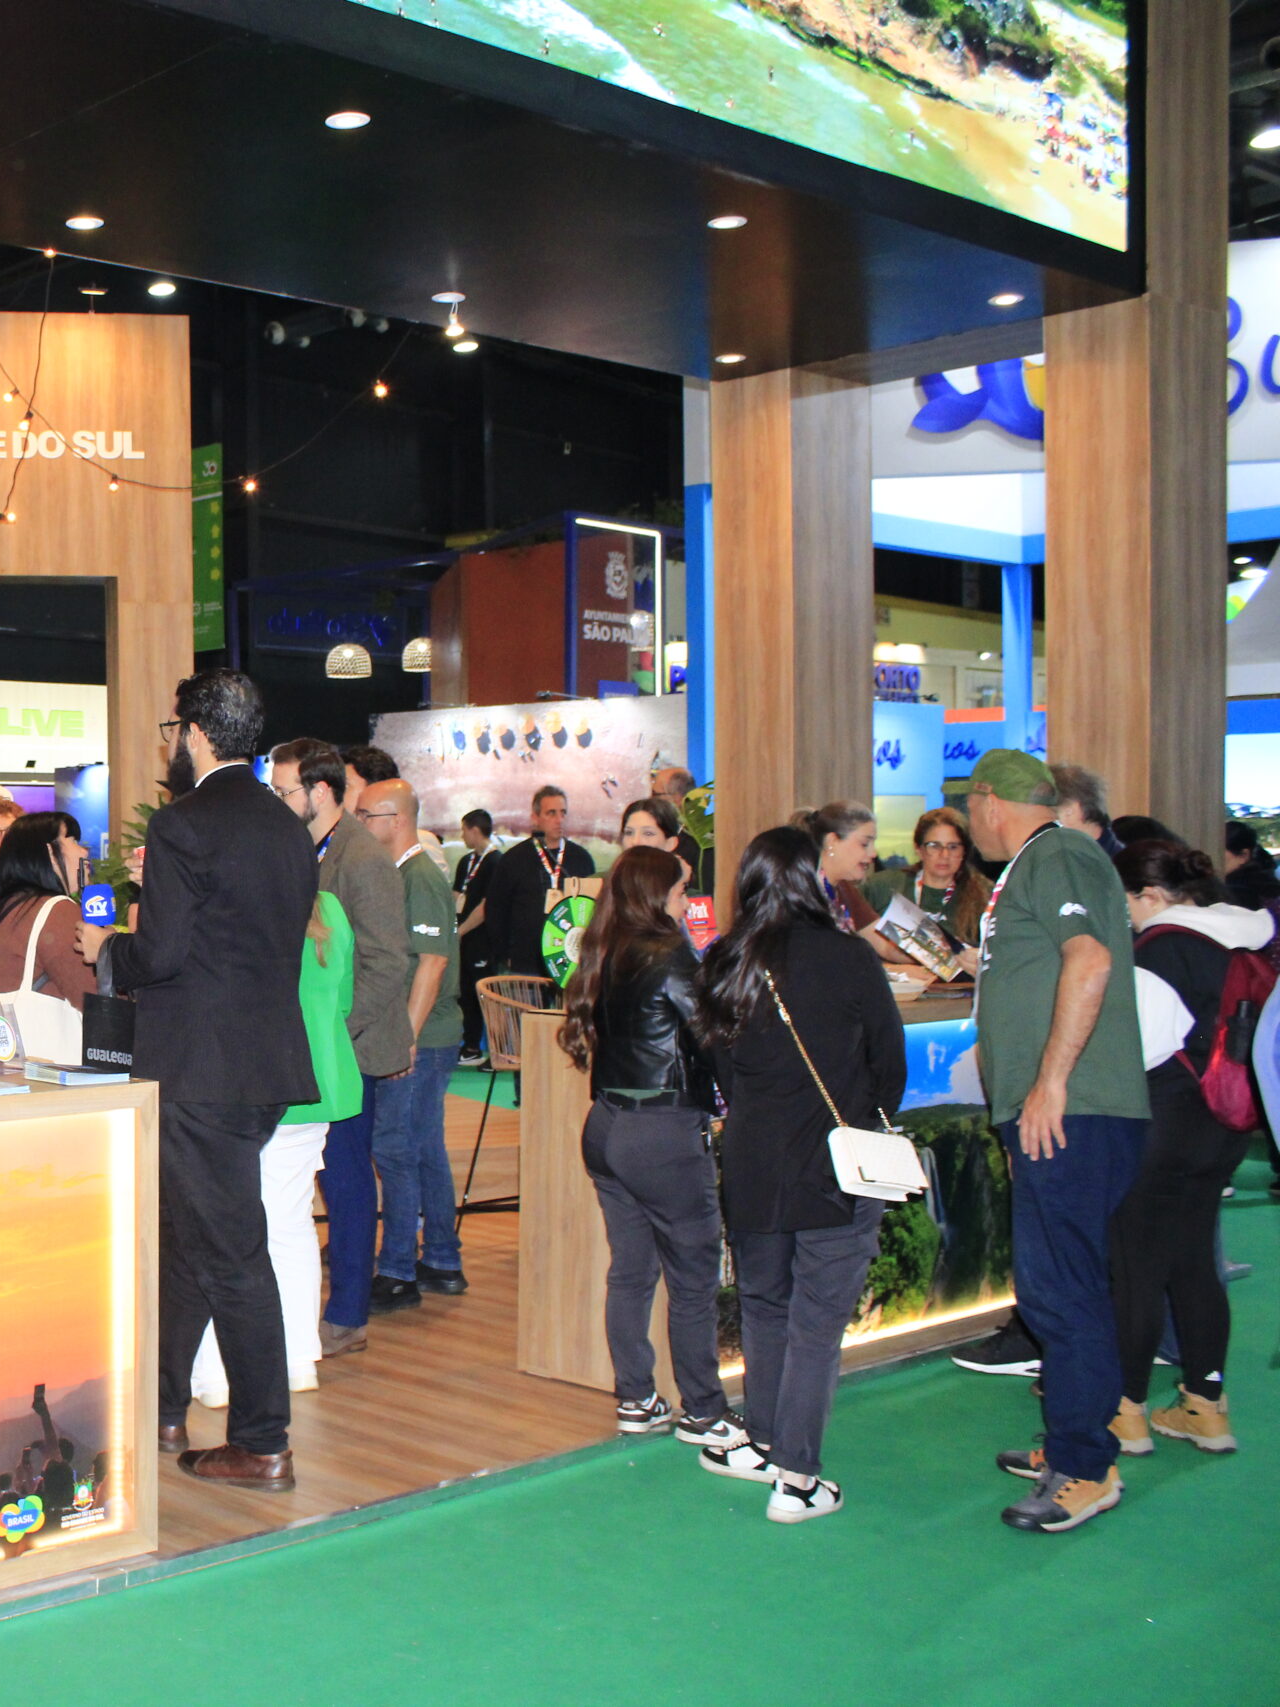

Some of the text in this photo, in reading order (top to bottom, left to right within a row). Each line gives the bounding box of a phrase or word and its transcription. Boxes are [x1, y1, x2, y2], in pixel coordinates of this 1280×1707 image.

[12, 431, 65, 459] DO
[72, 430, 145, 459] SUL
[583, 622, 611, 642] SÃO
[7, 1514, 34, 1527] BRASIL
